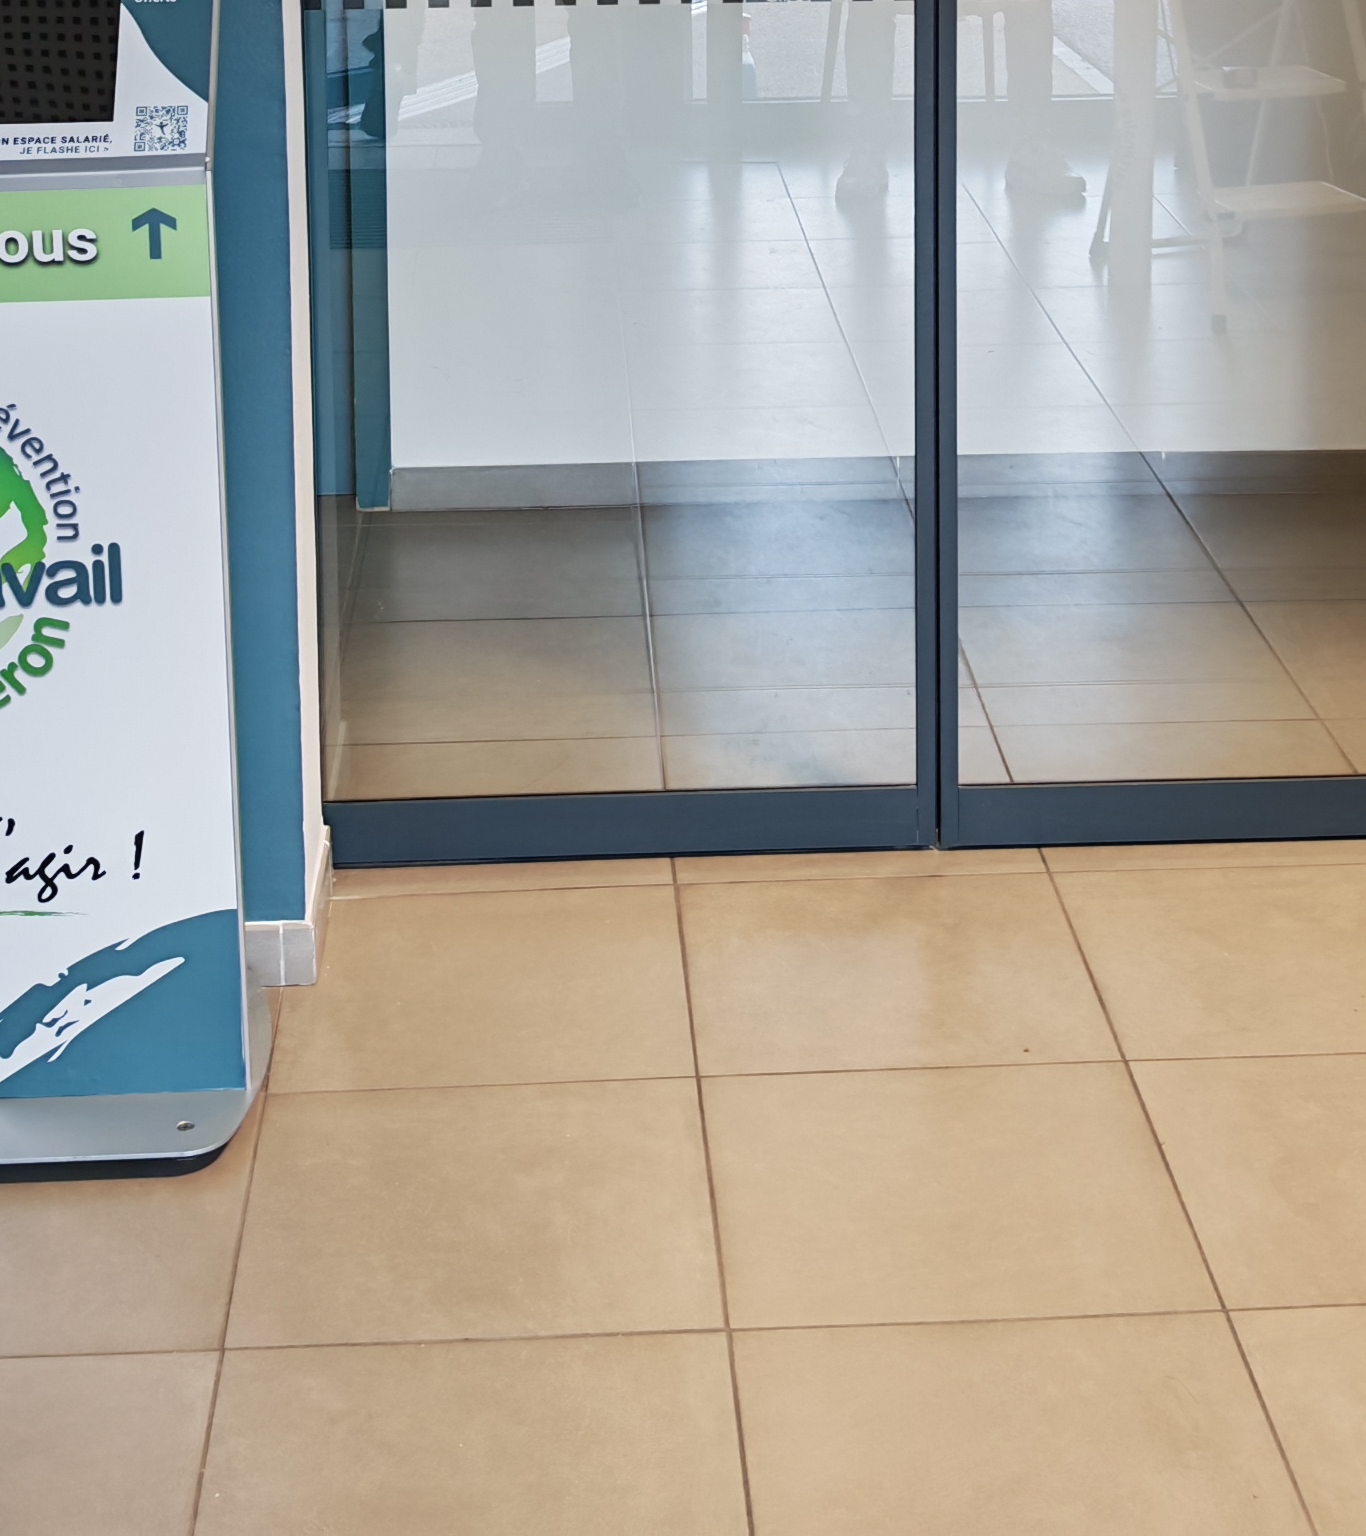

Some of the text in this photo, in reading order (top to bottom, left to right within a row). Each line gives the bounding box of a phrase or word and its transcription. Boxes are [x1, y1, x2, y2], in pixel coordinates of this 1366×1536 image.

[12, 136, 57, 146] ESPACE
[60, 133, 113, 144] SALARIÉ,
[19, 145, 100, 155] JE FLASHE ICI
[5, 845, 106, 905] agir
[132, 831, 144, 879] !
